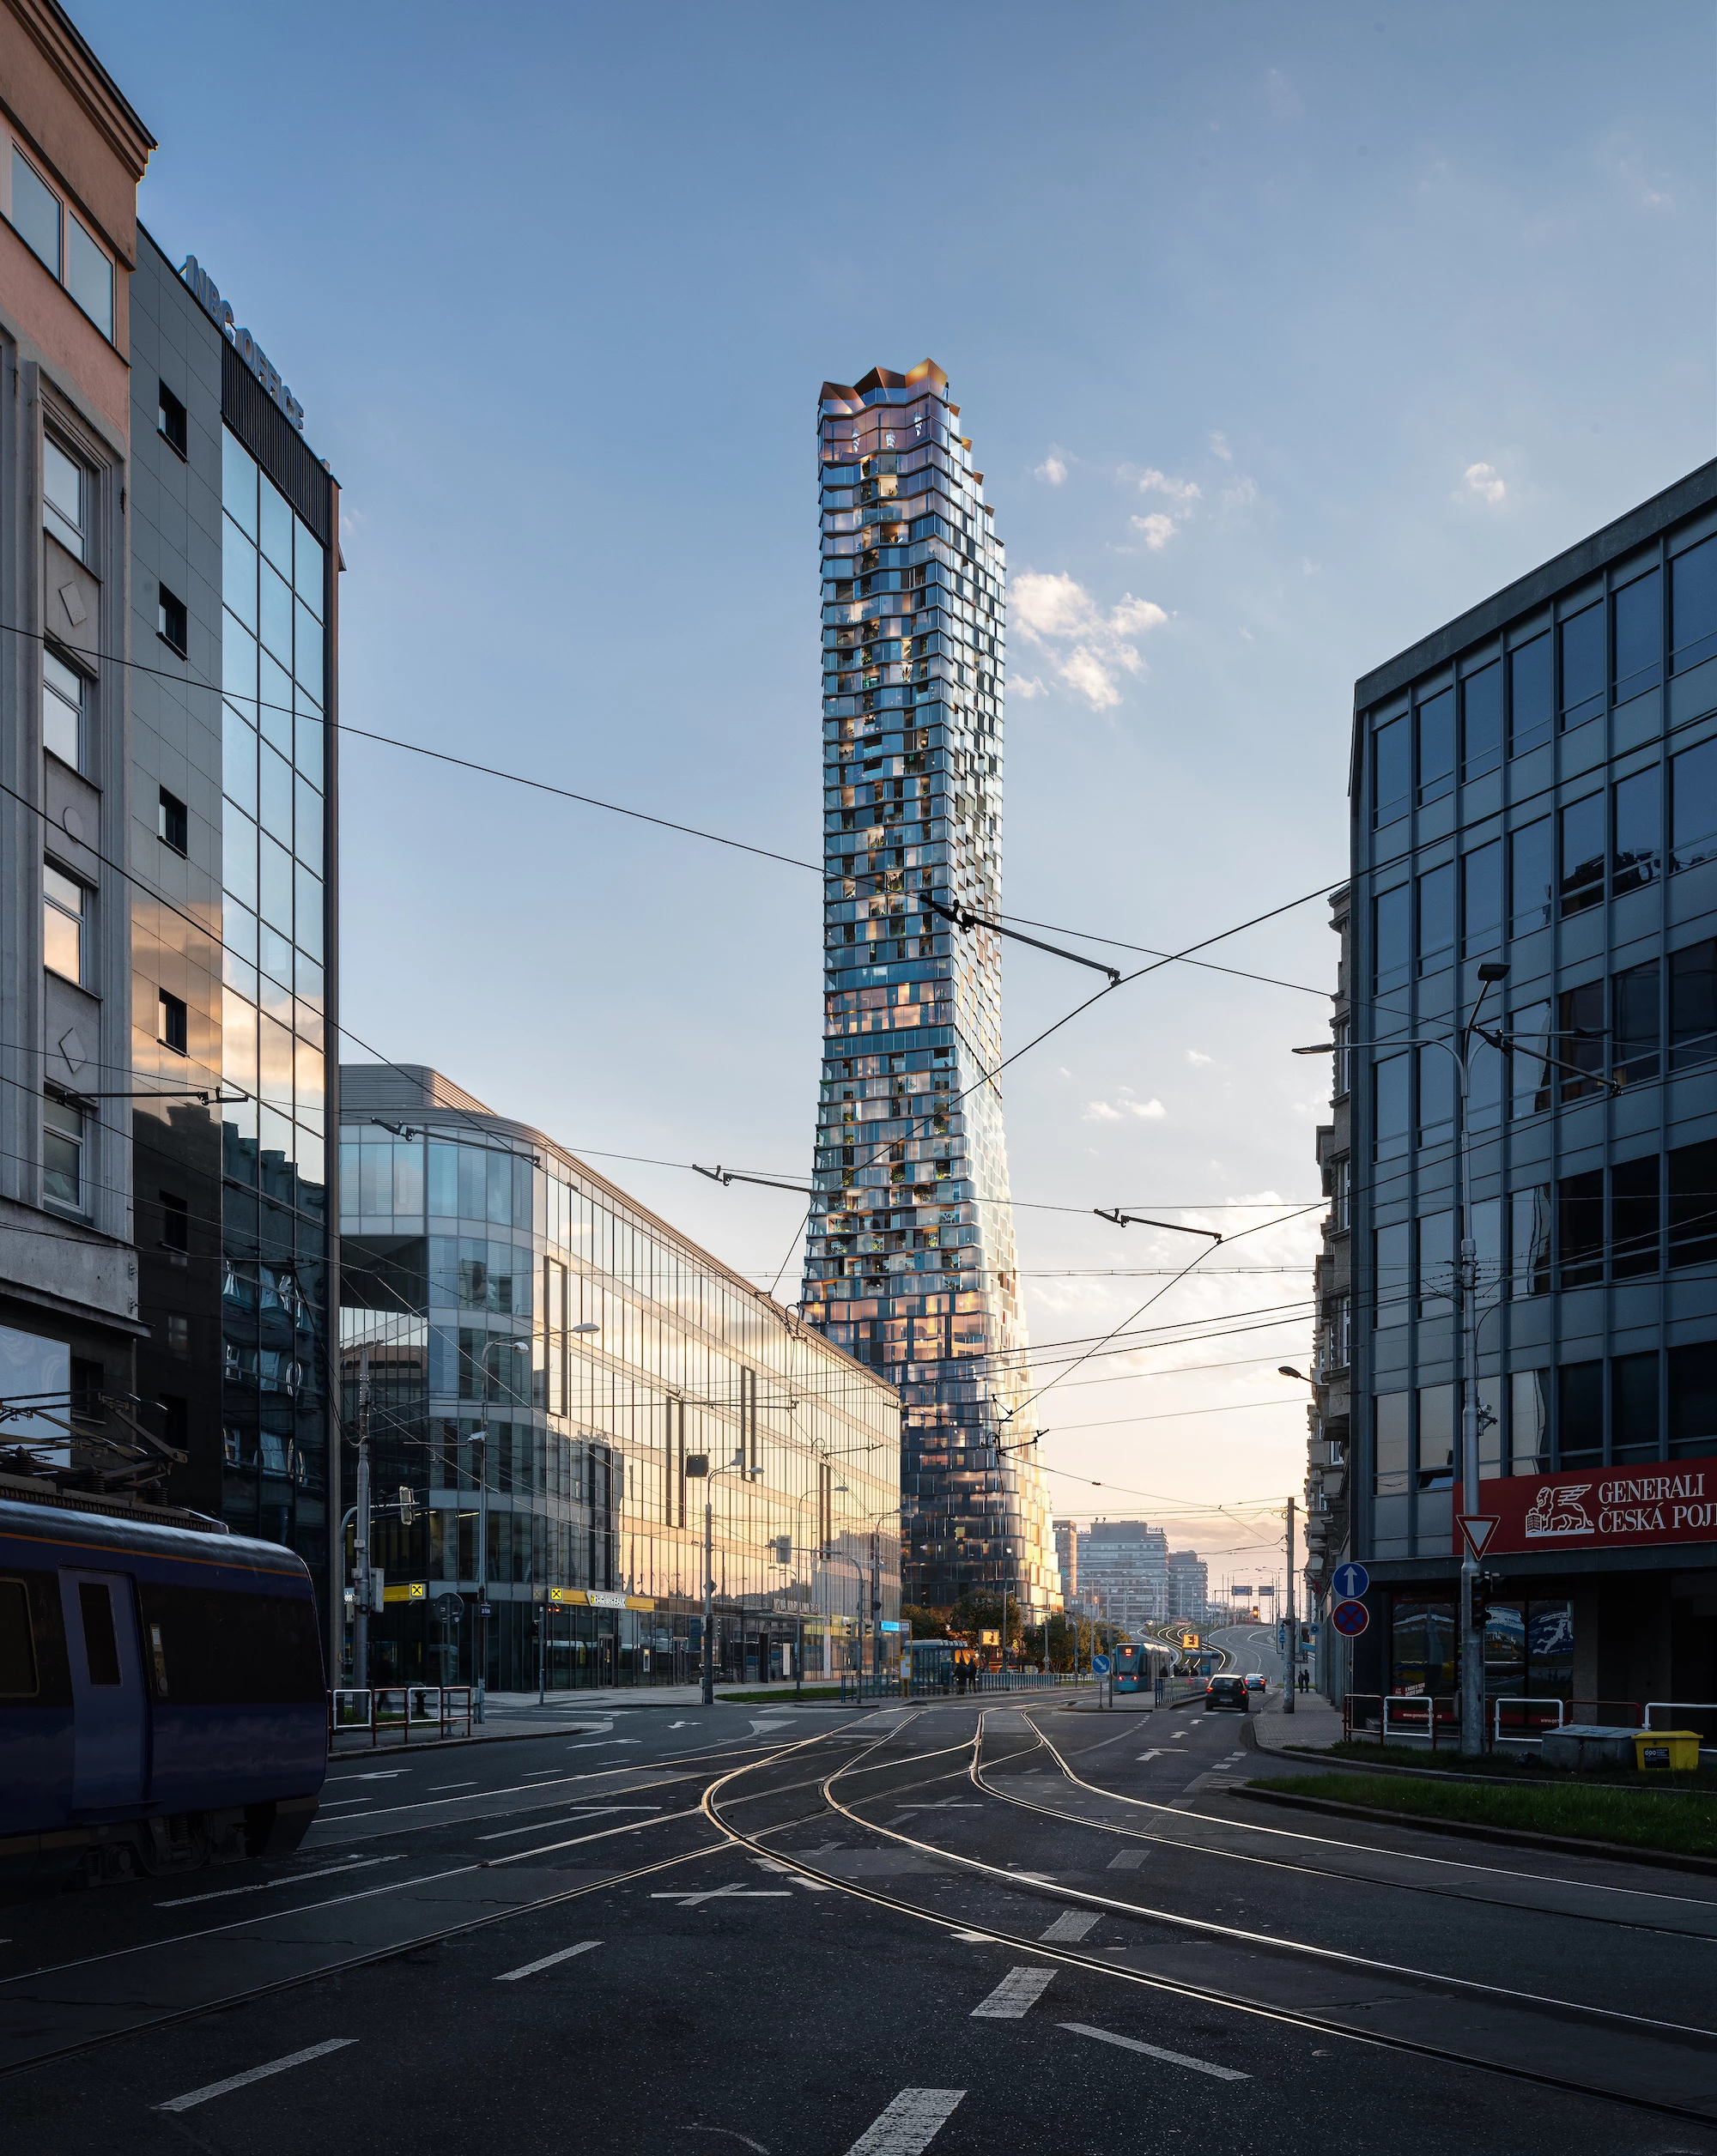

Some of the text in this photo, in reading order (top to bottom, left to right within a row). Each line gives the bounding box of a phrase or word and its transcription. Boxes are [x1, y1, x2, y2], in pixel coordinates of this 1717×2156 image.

[186, 255, 304, 431] NBC OFFICE
[1599, 1474, 1705, 1504] GENERALI
[1599, 1503, 1666, 1533] ČESKÁ
